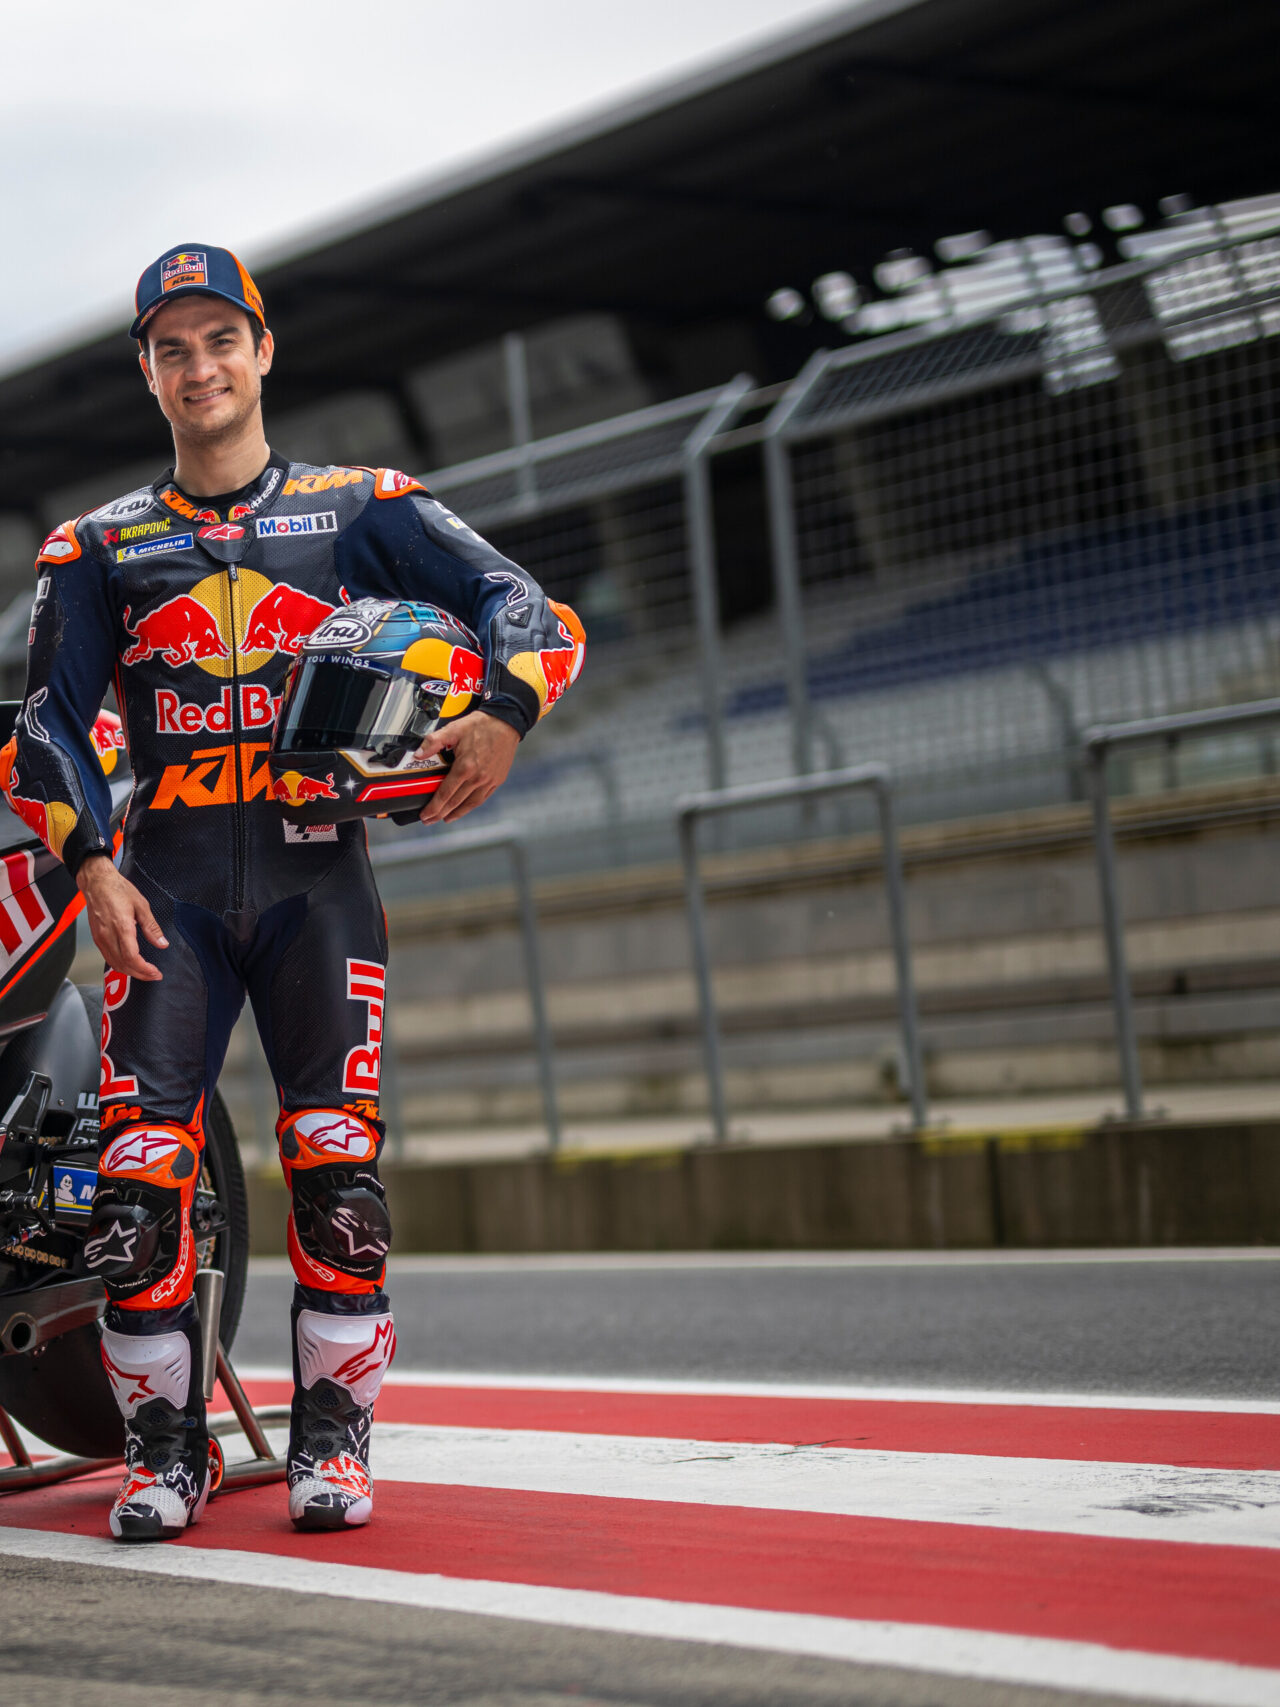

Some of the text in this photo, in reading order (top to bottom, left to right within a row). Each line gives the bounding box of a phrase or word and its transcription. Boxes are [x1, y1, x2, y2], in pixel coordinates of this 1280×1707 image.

[163, 262, 204, 281] Red Bull
[172, 275, 196, 286] KTM
[282, 470, 363, 496] KTM
[106, 496, 150, 518] Arai
[159, 490, 199, 520] KTM
[120, 517, 171, 541] AKRAPOVIČ
[258, 516, 313, 535] Mobil
[138, 539, 186, 554] MICHELIN
[315, 622, 363, 640] Arai
[306, 655, 326, 663] YOU
[331, 656, 371, 668] WINGS
[155, 685, 234, 734] Red
[342, 958, 385, 1096] Bull
